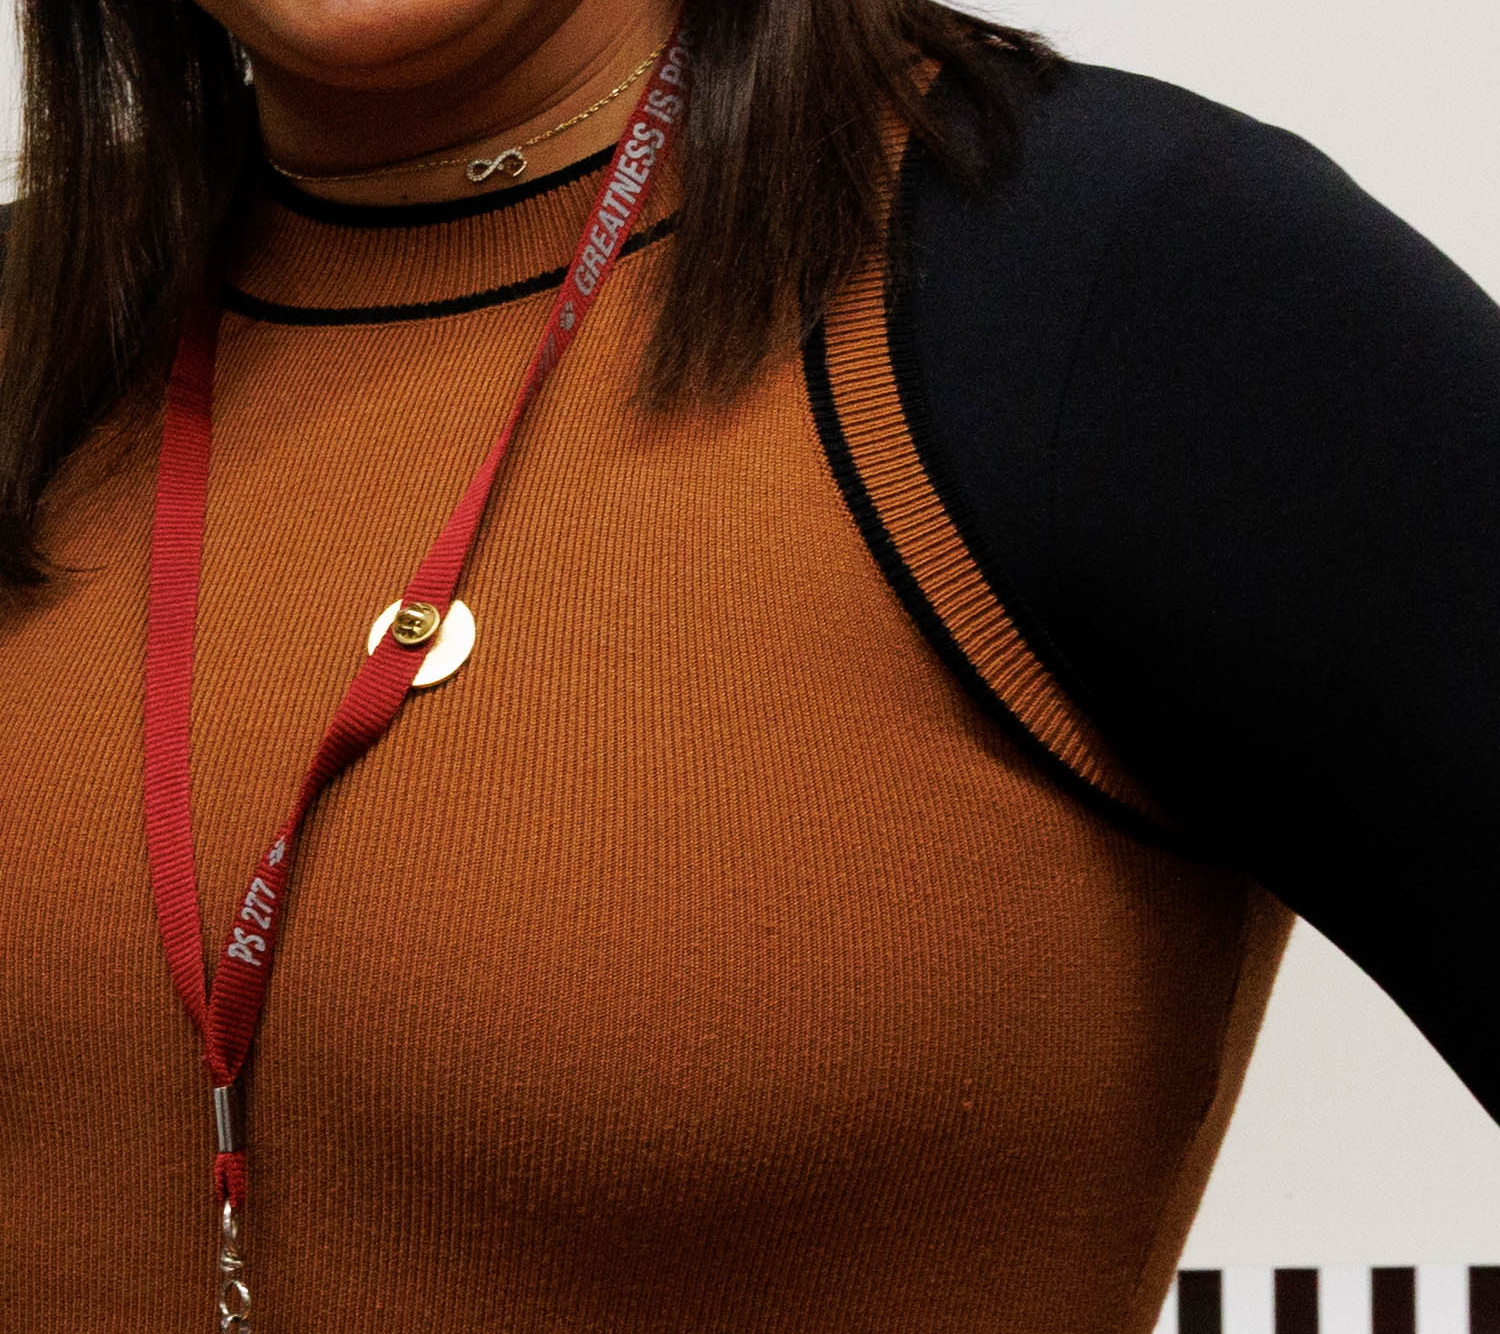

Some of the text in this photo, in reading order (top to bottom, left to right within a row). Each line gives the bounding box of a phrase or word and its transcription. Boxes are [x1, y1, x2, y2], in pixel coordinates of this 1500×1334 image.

[574, 122, 665, 296] GREATNESS
[227, 877, 278, 966] PS 277
